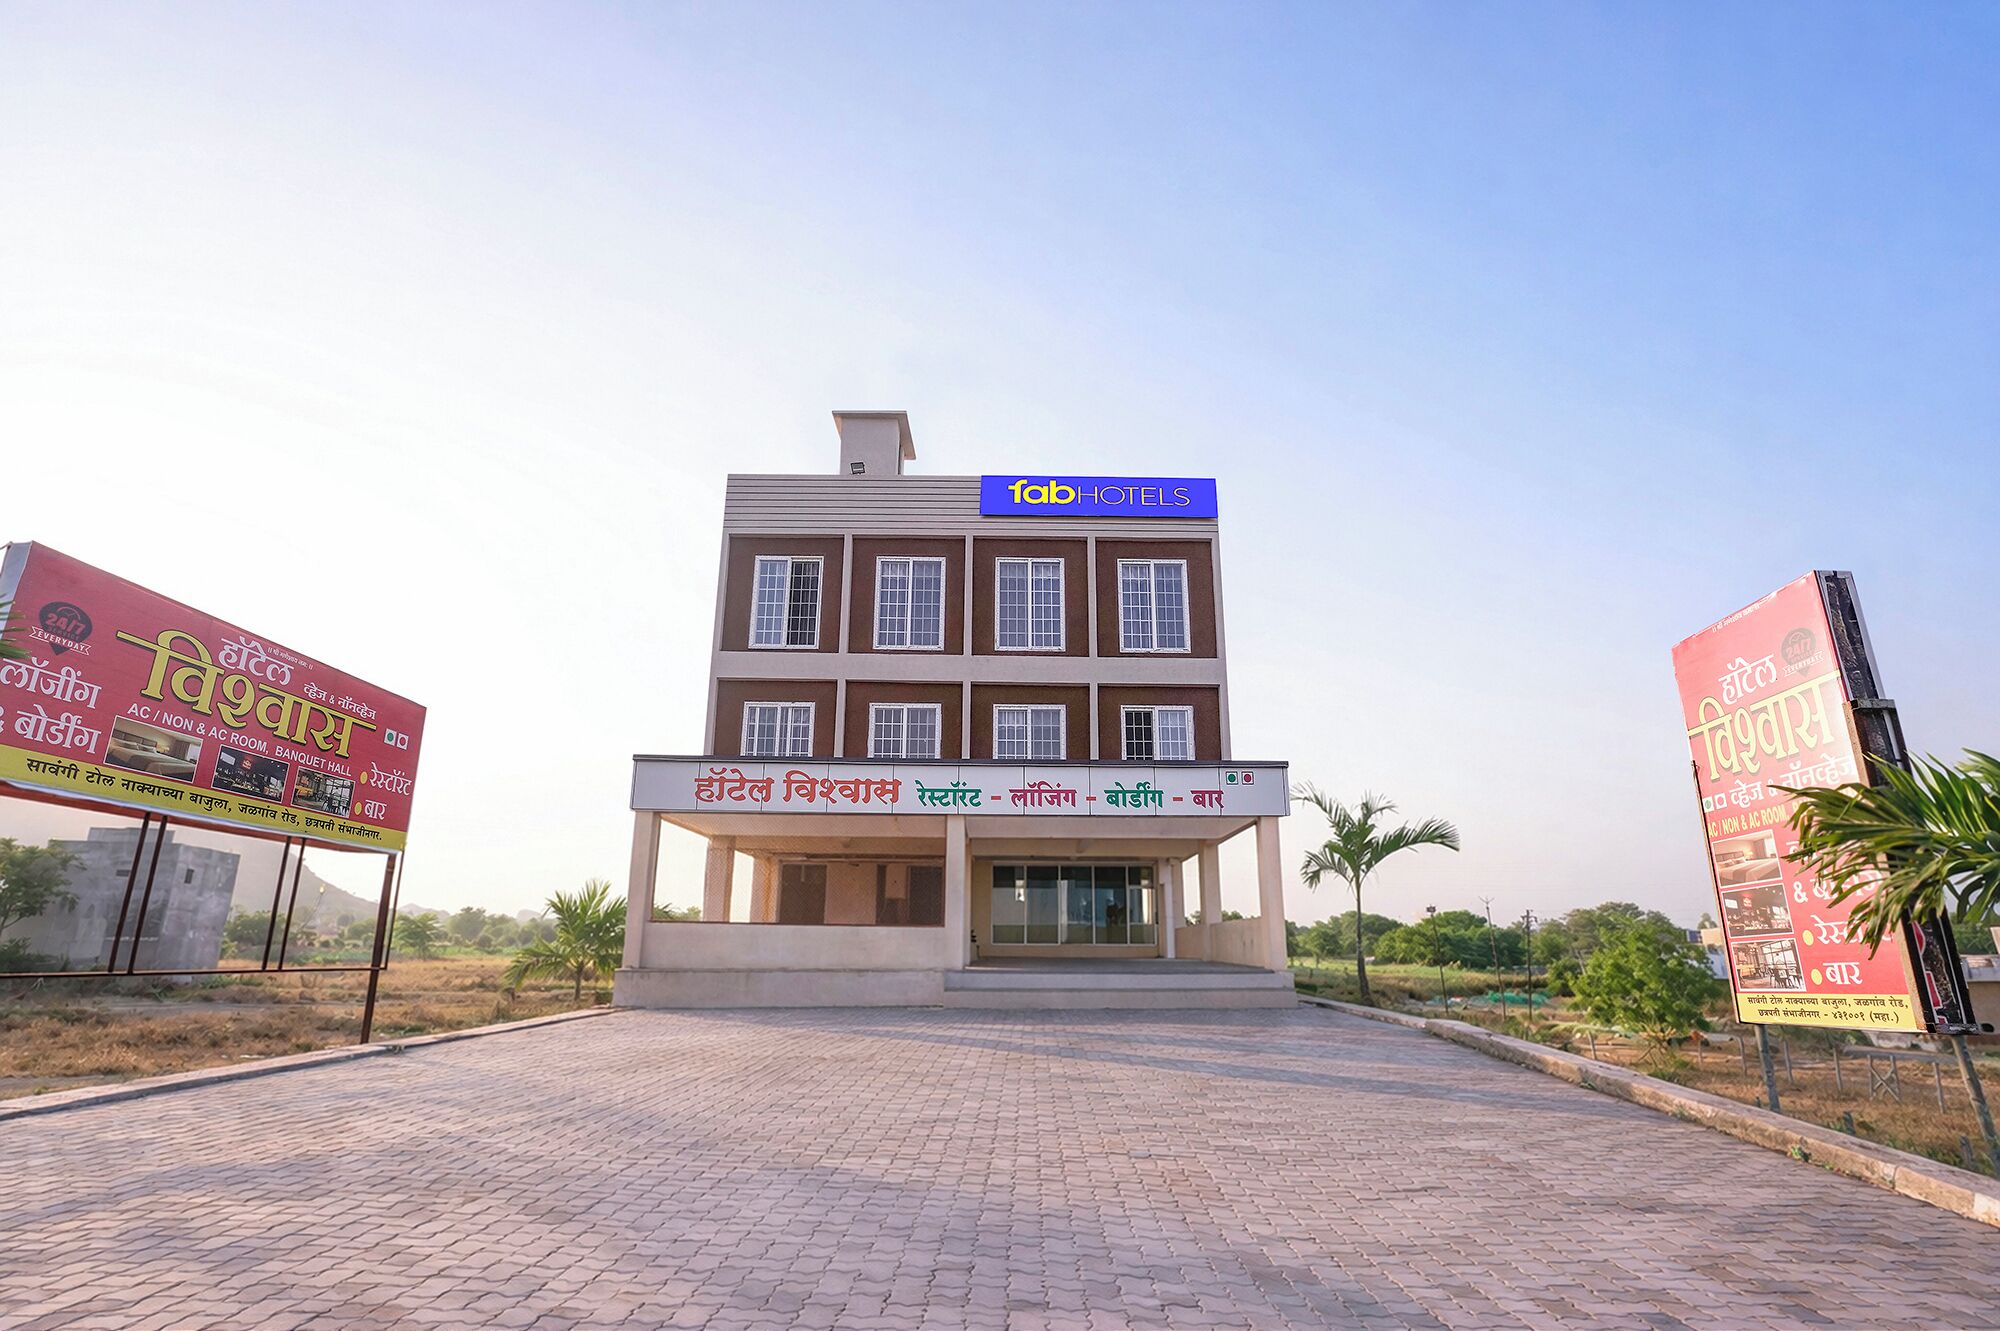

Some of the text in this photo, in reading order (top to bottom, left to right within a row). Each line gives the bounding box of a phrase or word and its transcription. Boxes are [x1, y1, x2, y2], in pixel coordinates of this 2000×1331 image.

[1007, 479, 1191, 507] fabHOTELS
[46, 613, 86, 635] 24/7
[37, 630, 87, 651] EVERYDAY
[218, 635, 294, 686] हॉटेल
[0, 657, 102, 709] लॉजींग
[116, 629, 377, 758] विश्वास
[303, 682, 327, 701] व्हेज
[328, 694, 335, 705] &
[1718, 654, 1777, 705] हॉटेल
[14, 703, 102, 755] बोर्डींग
[127, 703, 151, 720] AC
[161, 714, 194, 732] NON
[196, 722, 206, 735] &
[208, 726, 227, 741] AC
[229, 733, 269, 755] ROOM,
[275, 744, 327, 770] BANQUET
[327, 761, 352, 777] HALL
[1687, 670, 1842, 782] विश्वास
[369, 762, 413, 796] रेस्टॉरंट
[694, 767, 775, 803] हॉटेल
[783, 770, 902, 804] विश्वास
[915, 779, 982, 807] रेस्टॉरंट
[1008, 781, 1078, 808] लॉजिंग
[1104, 781, 1164, 809] बोर्डींग
[1190, 789, 1225, 809] बार
[1729, 780, 1764, 808] व्हेज
[1767, 779, 1777, 797] &
[26, 758, 382, 841] सावंगी टोल नाक्याच्या बाजुला, जळगांव रोड, छत्रपती संभाजीनगर.
[364, 799, 388, 821] बार
[1708, 822, 1718, 838] AC
[1722, 817, 1740, 836] NON
[1741, 815, 1748, 829] &
[1749, 812, 1761, 828] AC
[1793, 881, 1808, 903] &
[1823, 961, 1863, 985] बार
[1888, 997, 1909, 1009] रोड,
